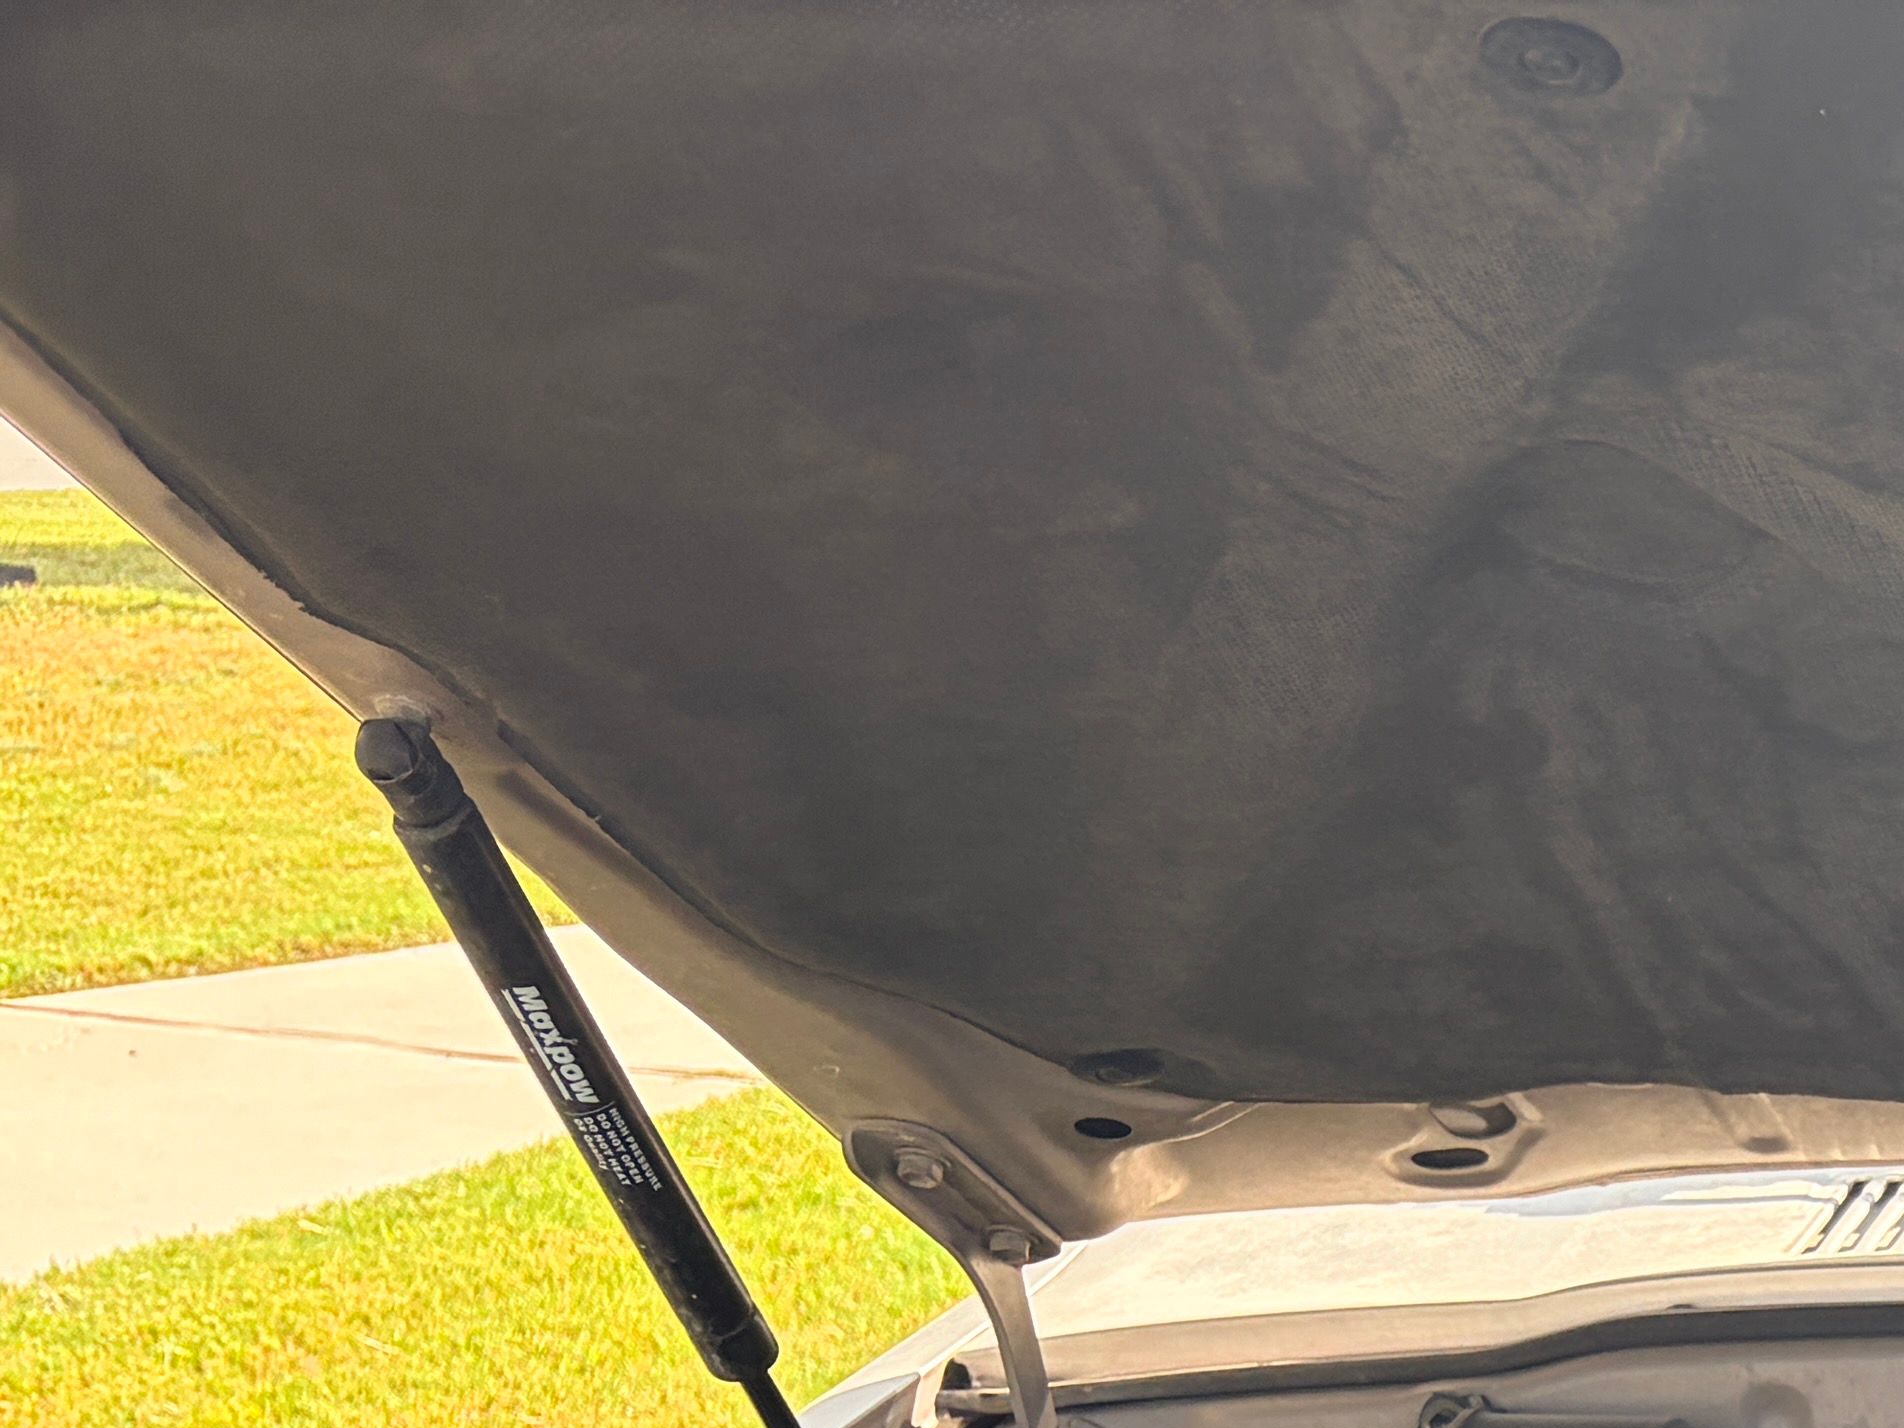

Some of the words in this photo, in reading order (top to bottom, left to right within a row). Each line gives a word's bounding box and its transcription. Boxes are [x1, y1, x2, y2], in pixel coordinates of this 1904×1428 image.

[512, 985, 600, 1104] Maxpow
[582, 1116, 599, 1134] DO
[593, 1134, 614, 1156] NOT
[608, 1156, 633, 1188] HEAT
[596, 1113, 611, 1130] DO
[607, 1131, 627, 1153] NOT
[621, 1153, 645, 1185] OPEN
[609, 1107, 628, 1136] HIGH
[626, 1136, 664, 1193] PRESSURE
